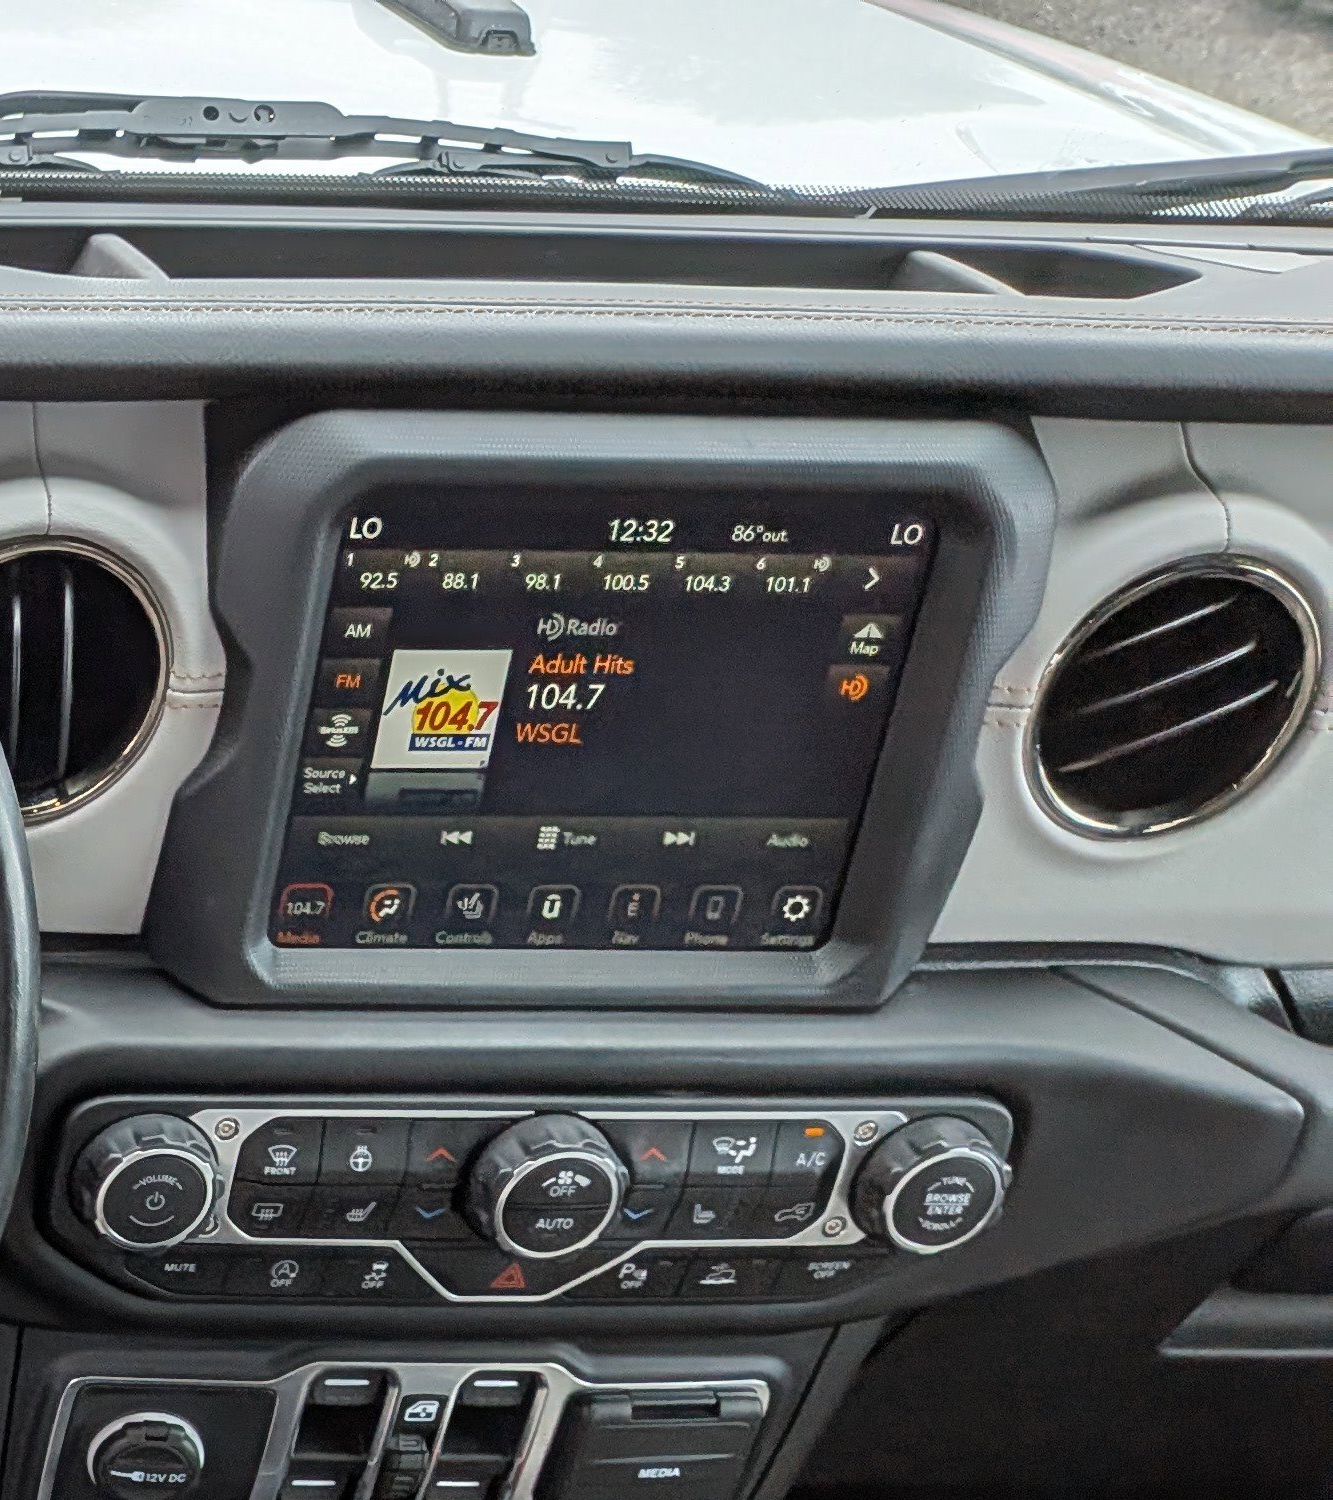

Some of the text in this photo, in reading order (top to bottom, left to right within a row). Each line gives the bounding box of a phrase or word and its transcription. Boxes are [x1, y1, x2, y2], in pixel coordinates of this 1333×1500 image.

[349, 516, 383, 539] LO
[608, 518, 675, 543] 12:32
[890, 523, 924, 546] LO
[346, 553, 354, 567] 1
[428, 553, 439, 567] 2
[511, 554, 521, 568] 3
[592, 554, 604, 568] 4
[674, 555, 685, 570] 5
[756, 557, 766, 571] 6
[359, 572, 399, 590] 92.5
[441, 572, 479, 590] 88.1
[525, 573, 561, 590] 98.1
[603, 573, 650, 591] 100.5
[685, 574, 731, 592] 104.3
[766, 576, 812, 593] 101.1
[344, 623, 372, 638] AM
[566, 617, 617, 637] Radio
[848, 641, 880, 657] Map
[528, 653, 635, 675] Adult Hits
[336, 673, 361, 689] FM
[383, 668, 472, 716] Mix
[526, 683, 606, 710] 104.7
[416, 701, 499, 732] 104.7
[516, 722, 583, 744] WSGL
[303, 766, 346, 780] Source
[303, 781, 342, 795] Select
[563, 831, 597, 846] Tune
[766, 832, 811, 848] Audio
[286, 901, 325, 915] 104.7
[796, 1151, 827, 1167] A/C
[263, 1166, 297, 1176] FRONT
[717, 1165, 744, 1175] MODE
[549, 1185, 577, 1198] OFF
[925, 1193, 972, 1203] BROWSE
[535, 1218, 575, 1230] AUTO
[164, 1263, 196, 1273] MUTE
[269, 1278, 292, 1289] OFF
[361, 1279, 385, 1290] OFF
[145, 1473, 188, 1483] 12V DC
[637, 1467, 681, 1479] MEDIA
